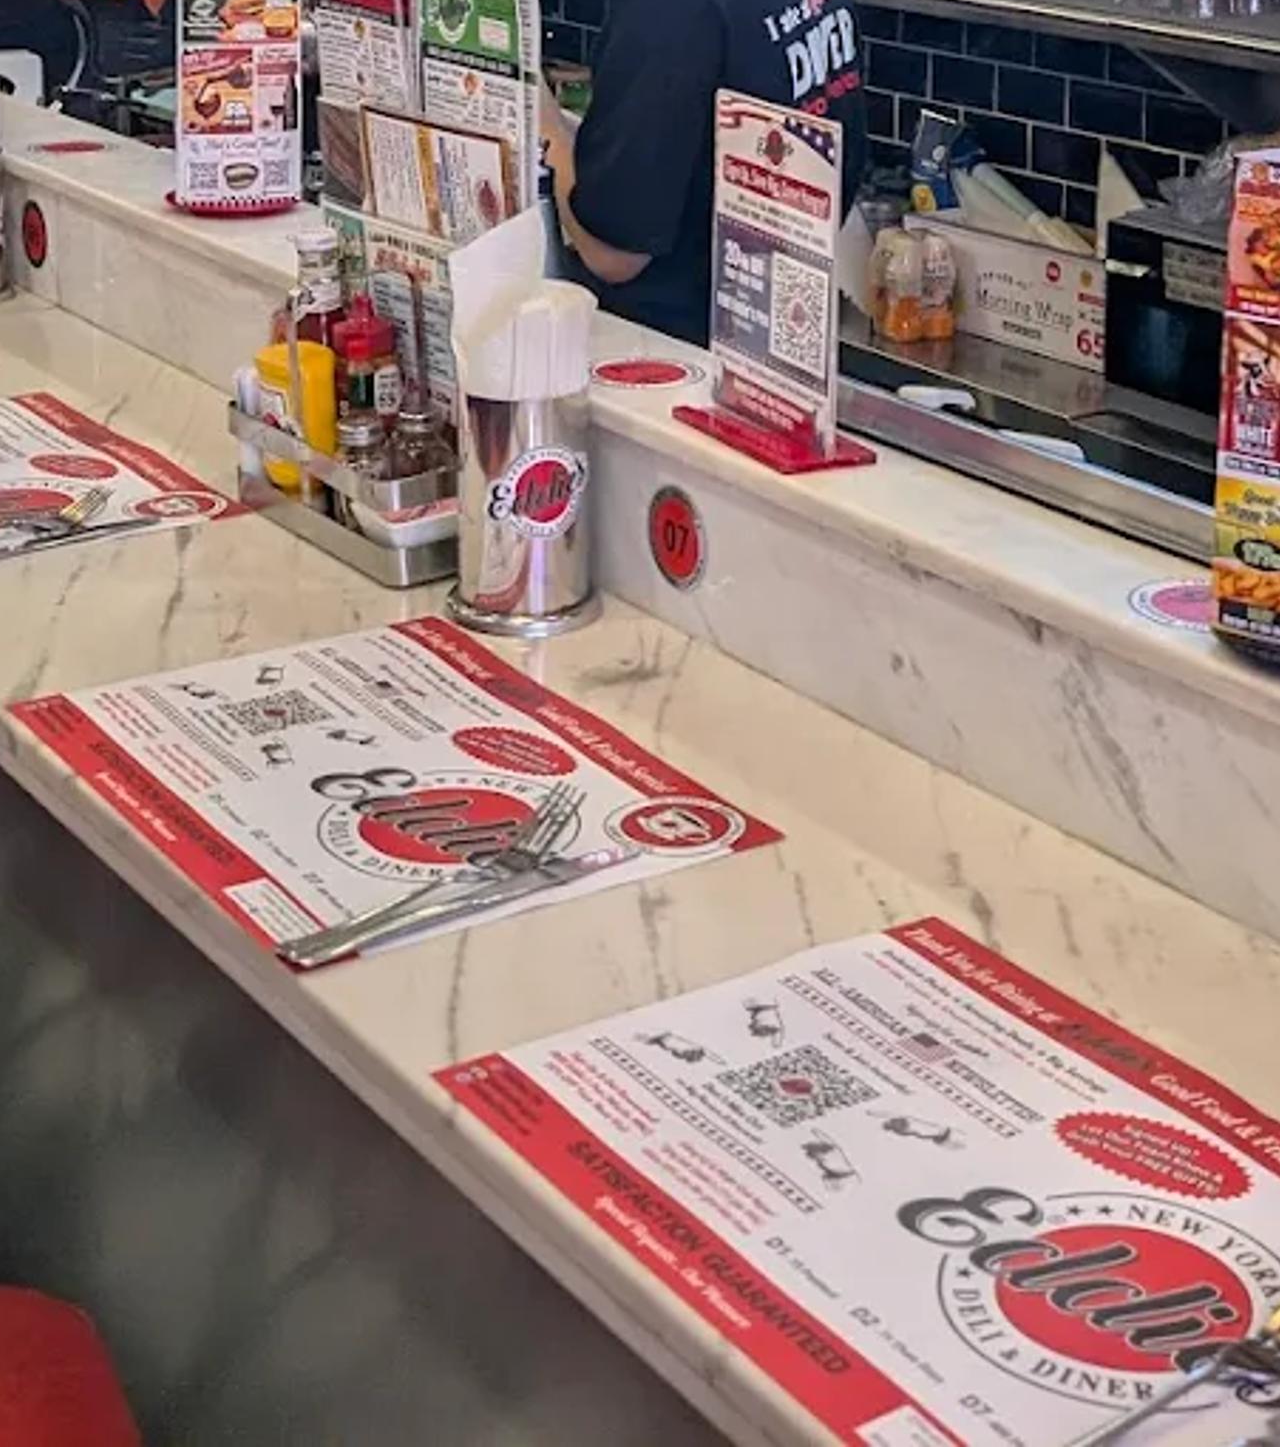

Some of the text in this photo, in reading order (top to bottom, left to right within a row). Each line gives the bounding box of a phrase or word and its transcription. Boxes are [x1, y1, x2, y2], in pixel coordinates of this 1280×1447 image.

[663, 519, 689, 562] 07
[1150, 1072, 1195, 1107] Good
[1191, 1096, 1241, 1129] Food
[1238, 1123, 1260, 1142] &
[1127, 1202, 1211, 1237] NEW
[567, 1138, 705, 1252] SATISFACTION
[701, 1249, 851, 1376] GUARANTEED
[953, 1287, 1002, 1346] DELI
[1032, 1356, 1157, 1401] DINER
